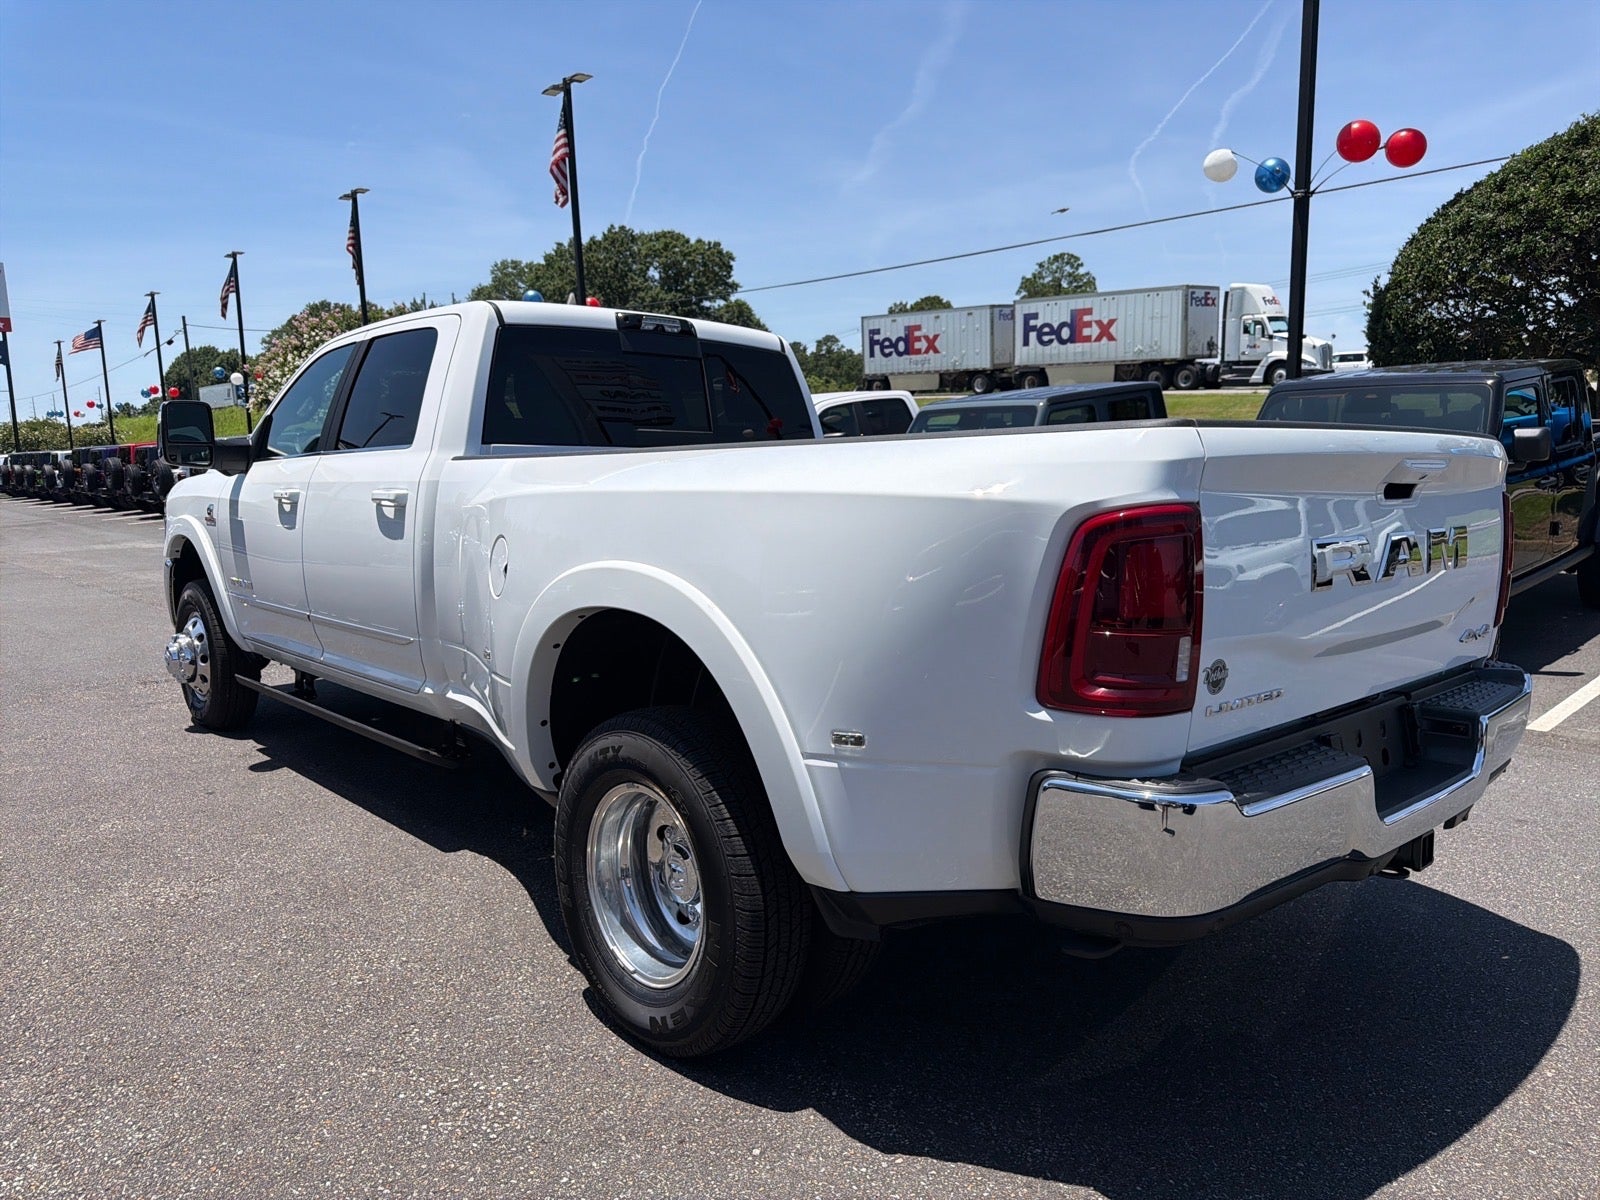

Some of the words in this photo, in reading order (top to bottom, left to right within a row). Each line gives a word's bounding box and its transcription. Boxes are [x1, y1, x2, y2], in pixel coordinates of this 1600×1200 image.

[1190, 291, 1217, 307] FedEx
[868, 324, 941, 358] FedEx
[1023, 307, 1118, 348] FedEx
[1310, 525, 1467, 592] RAM
[1205, 688, 1285, 717] LIMITED
